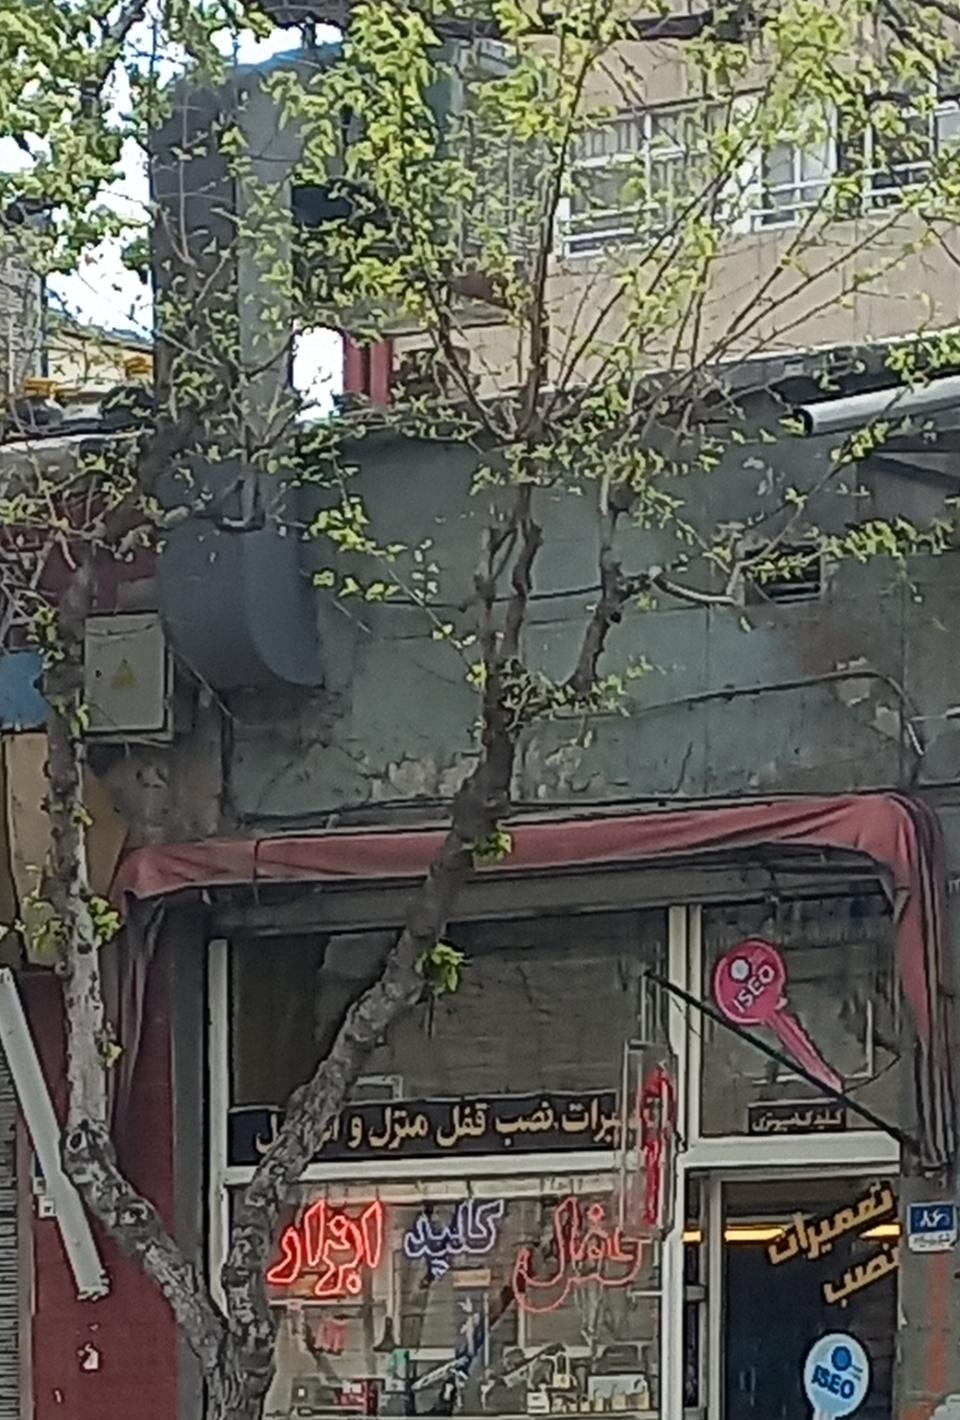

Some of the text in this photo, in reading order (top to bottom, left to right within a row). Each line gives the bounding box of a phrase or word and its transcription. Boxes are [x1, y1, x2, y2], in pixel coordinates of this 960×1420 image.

[731, 964, 775, 1013] ISEO
[348, 1116, 362, 1147] و
[369, 1106, 428, 1149] منزل
[440, 1103, 489, 1146] قفل
[495, 1100, 555, 1147] نصب
[404, 1200, 503, 1276] کلید
[768, 1179, 893, 1265] تعمیرات
[267, 1200, 383, 1296] ابزار
[823, 1243, 900, 1308] نصب
[811, 1365, 855, 1399] ISEO
